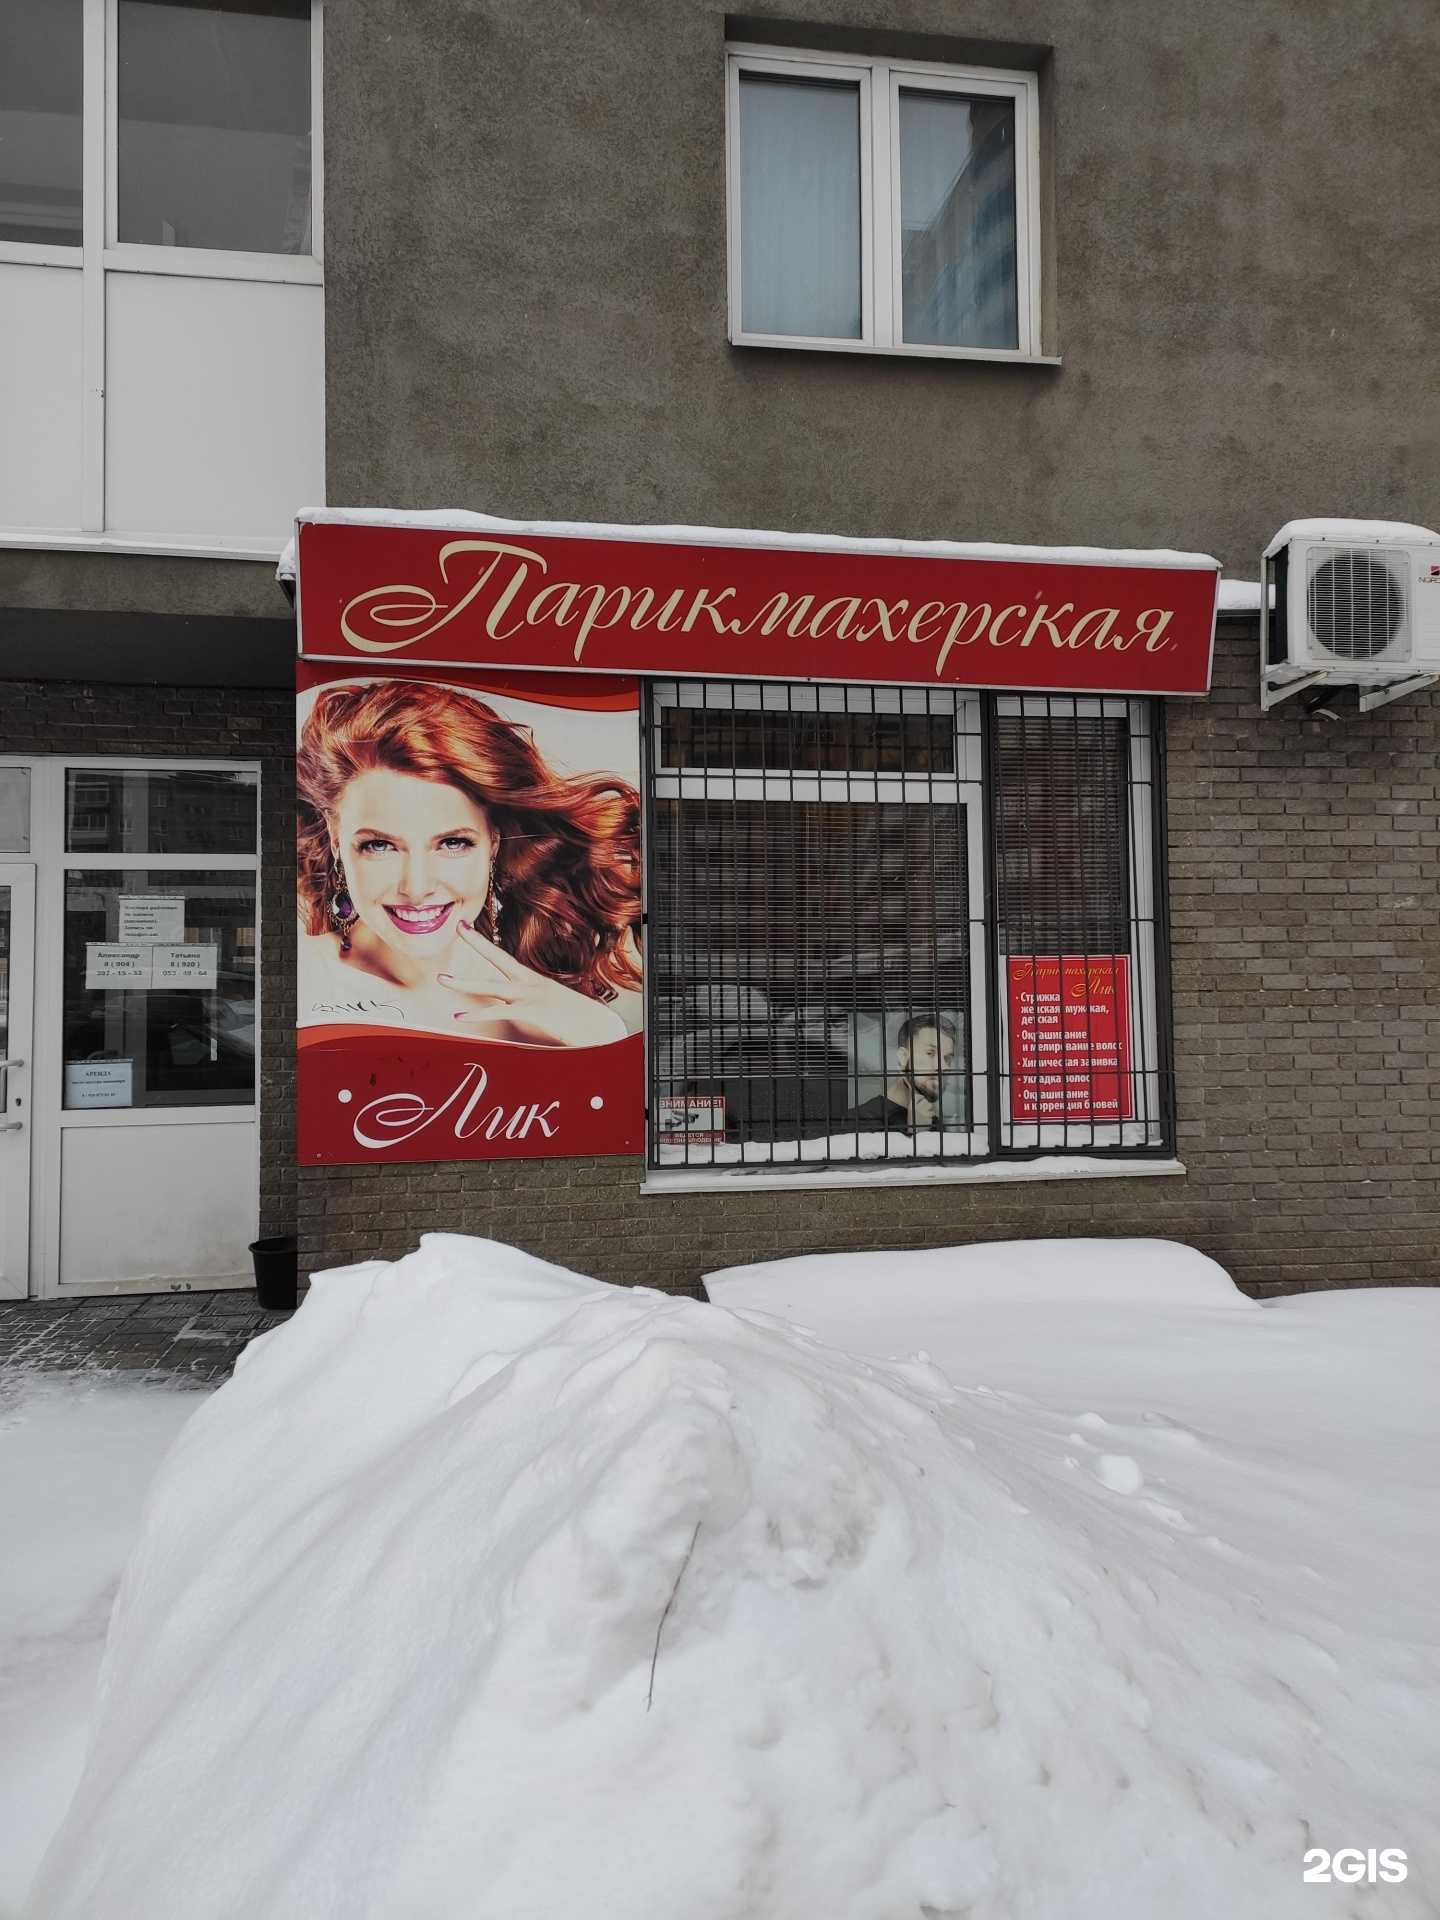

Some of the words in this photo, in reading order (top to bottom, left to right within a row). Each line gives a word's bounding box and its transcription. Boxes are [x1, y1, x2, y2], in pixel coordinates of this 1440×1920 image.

[340, 540, 1175, 677] Парикмахерская
[1066, 1004, 1111, 1016] мужкая,
[1023, 1057, 1080, 1067] Хиичесая
[353, 1063, 560, 1149] Лик
[1032, 1102, 1084, 1113] кррекция
[1086, 1099, 1120, 1110] бовей
